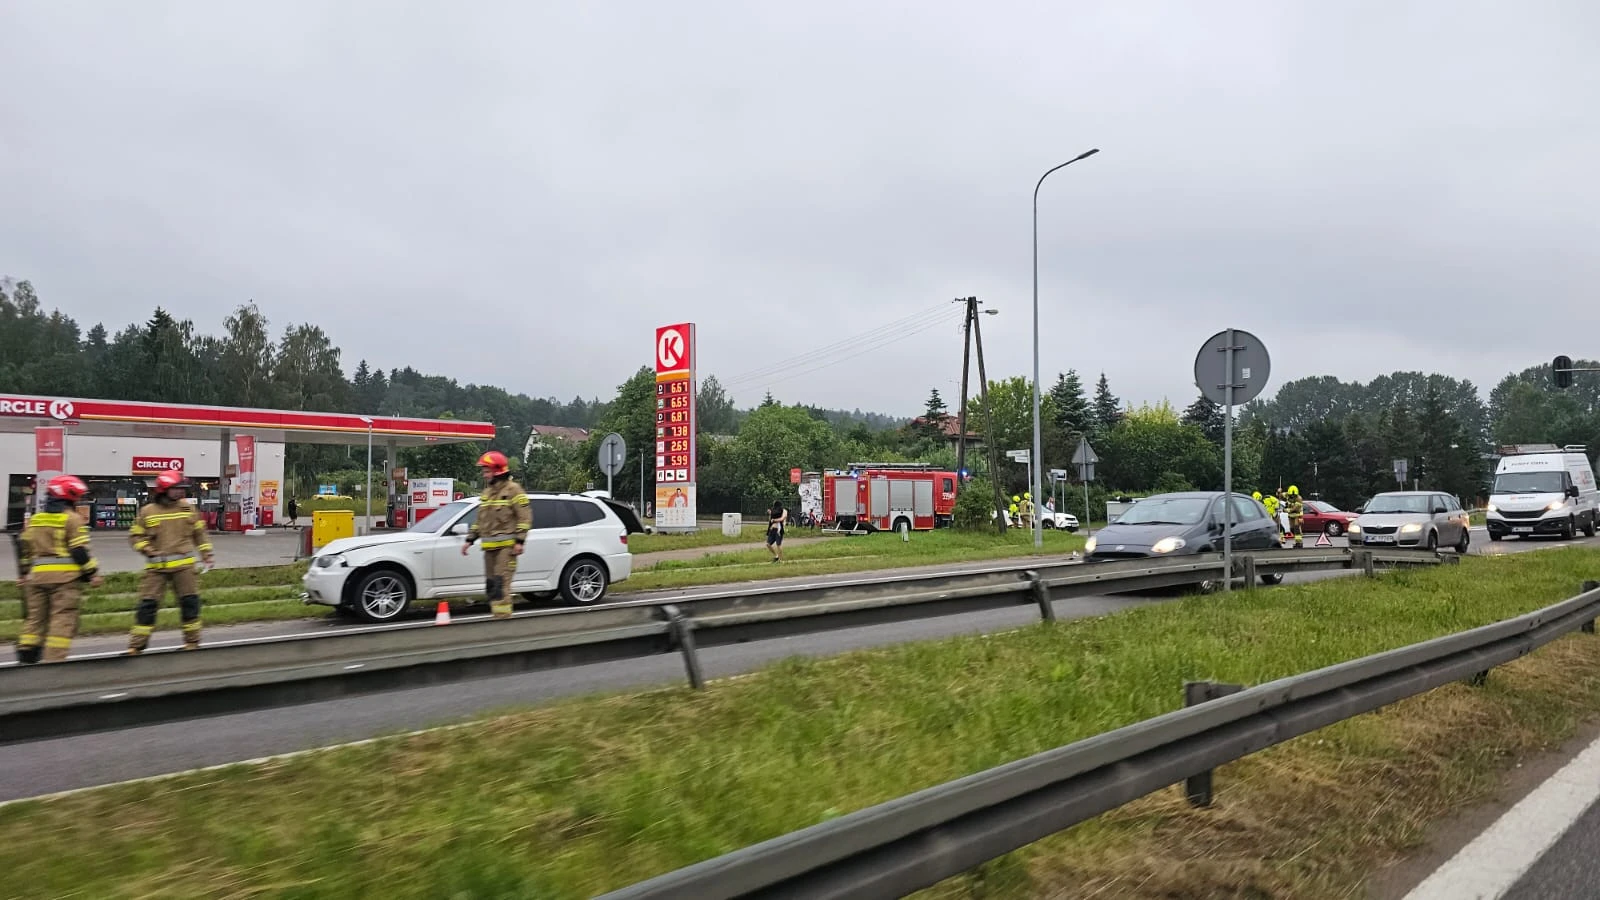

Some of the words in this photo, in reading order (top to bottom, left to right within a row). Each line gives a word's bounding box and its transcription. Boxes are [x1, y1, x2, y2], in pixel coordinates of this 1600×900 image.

[663, 333, 682, 364] K
[671, 381, 688, 394] 6.67
[671, 396, 688, 408] 6.65
[54, 402, 72, 418] K
[671, 410, 688, 422] 6.87
[136, 460, 169, 469] CIRCLE
